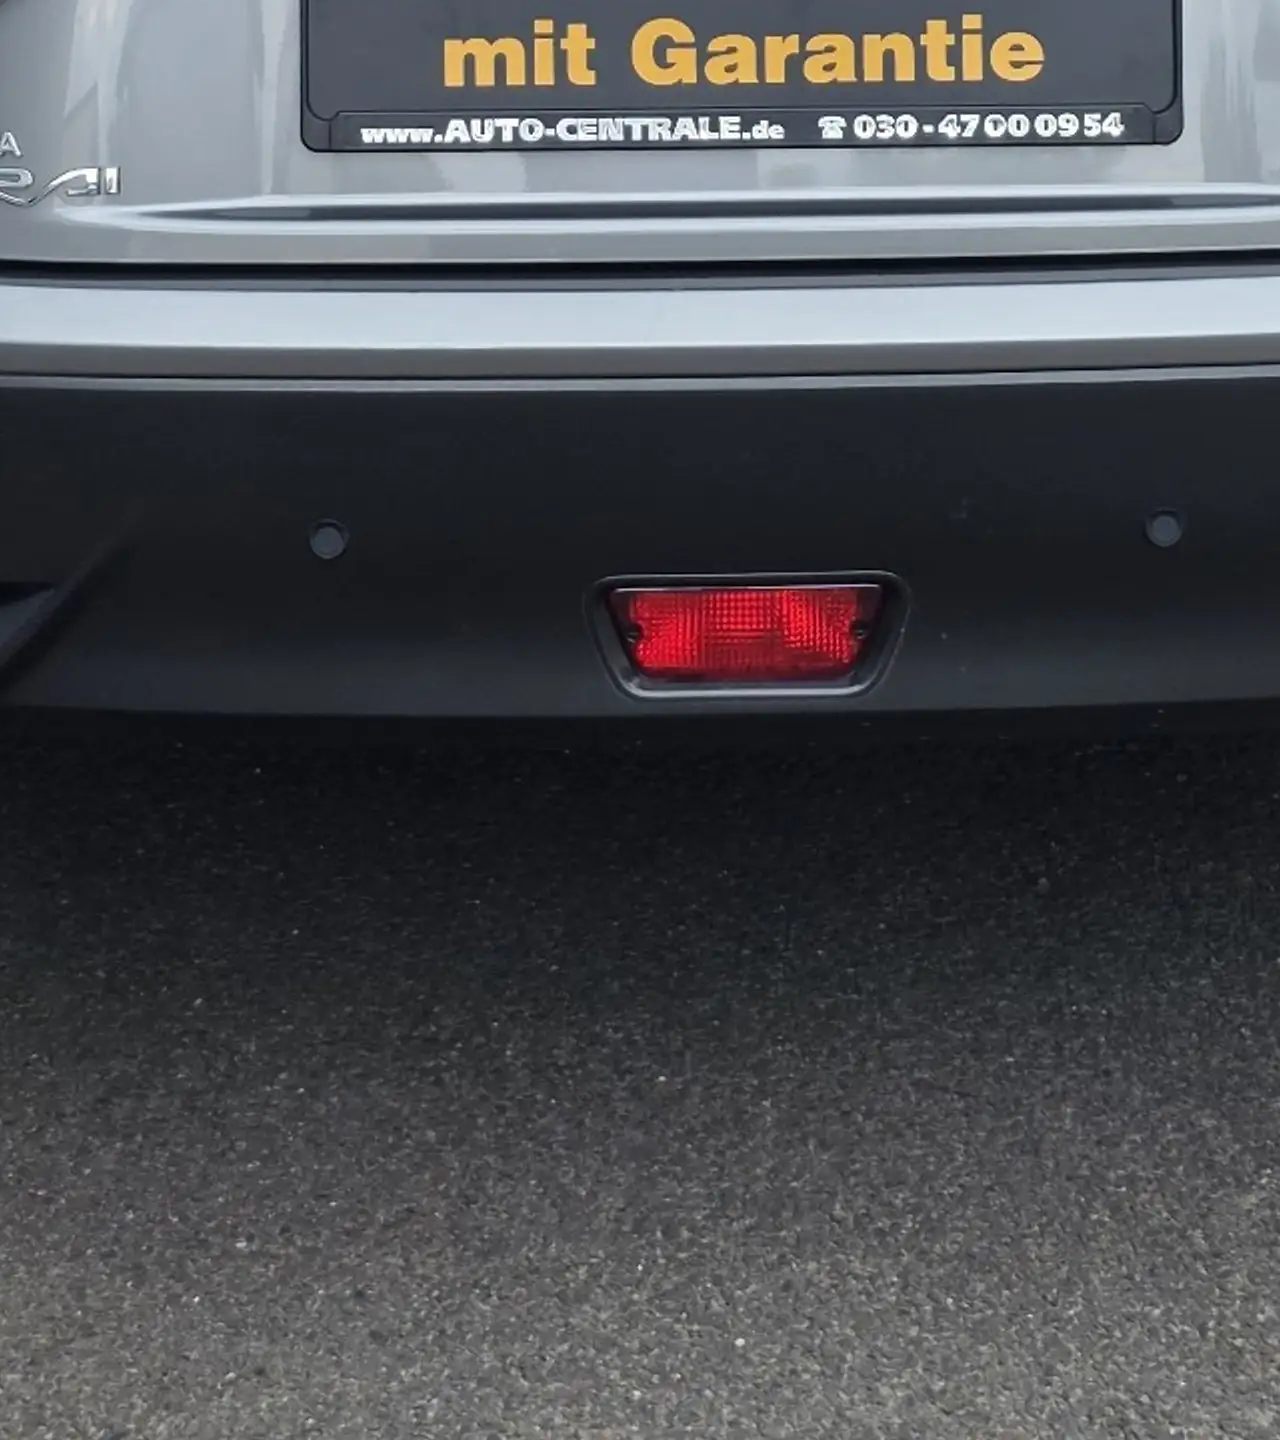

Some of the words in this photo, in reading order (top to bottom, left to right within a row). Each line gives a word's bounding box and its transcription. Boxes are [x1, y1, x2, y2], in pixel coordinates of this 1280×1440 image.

[443, 19, 597, 87] mit
[630, 13, 1045, 85] Garantie
[360, 116, 785, 143] www.AUTO-CENTRALE.de
